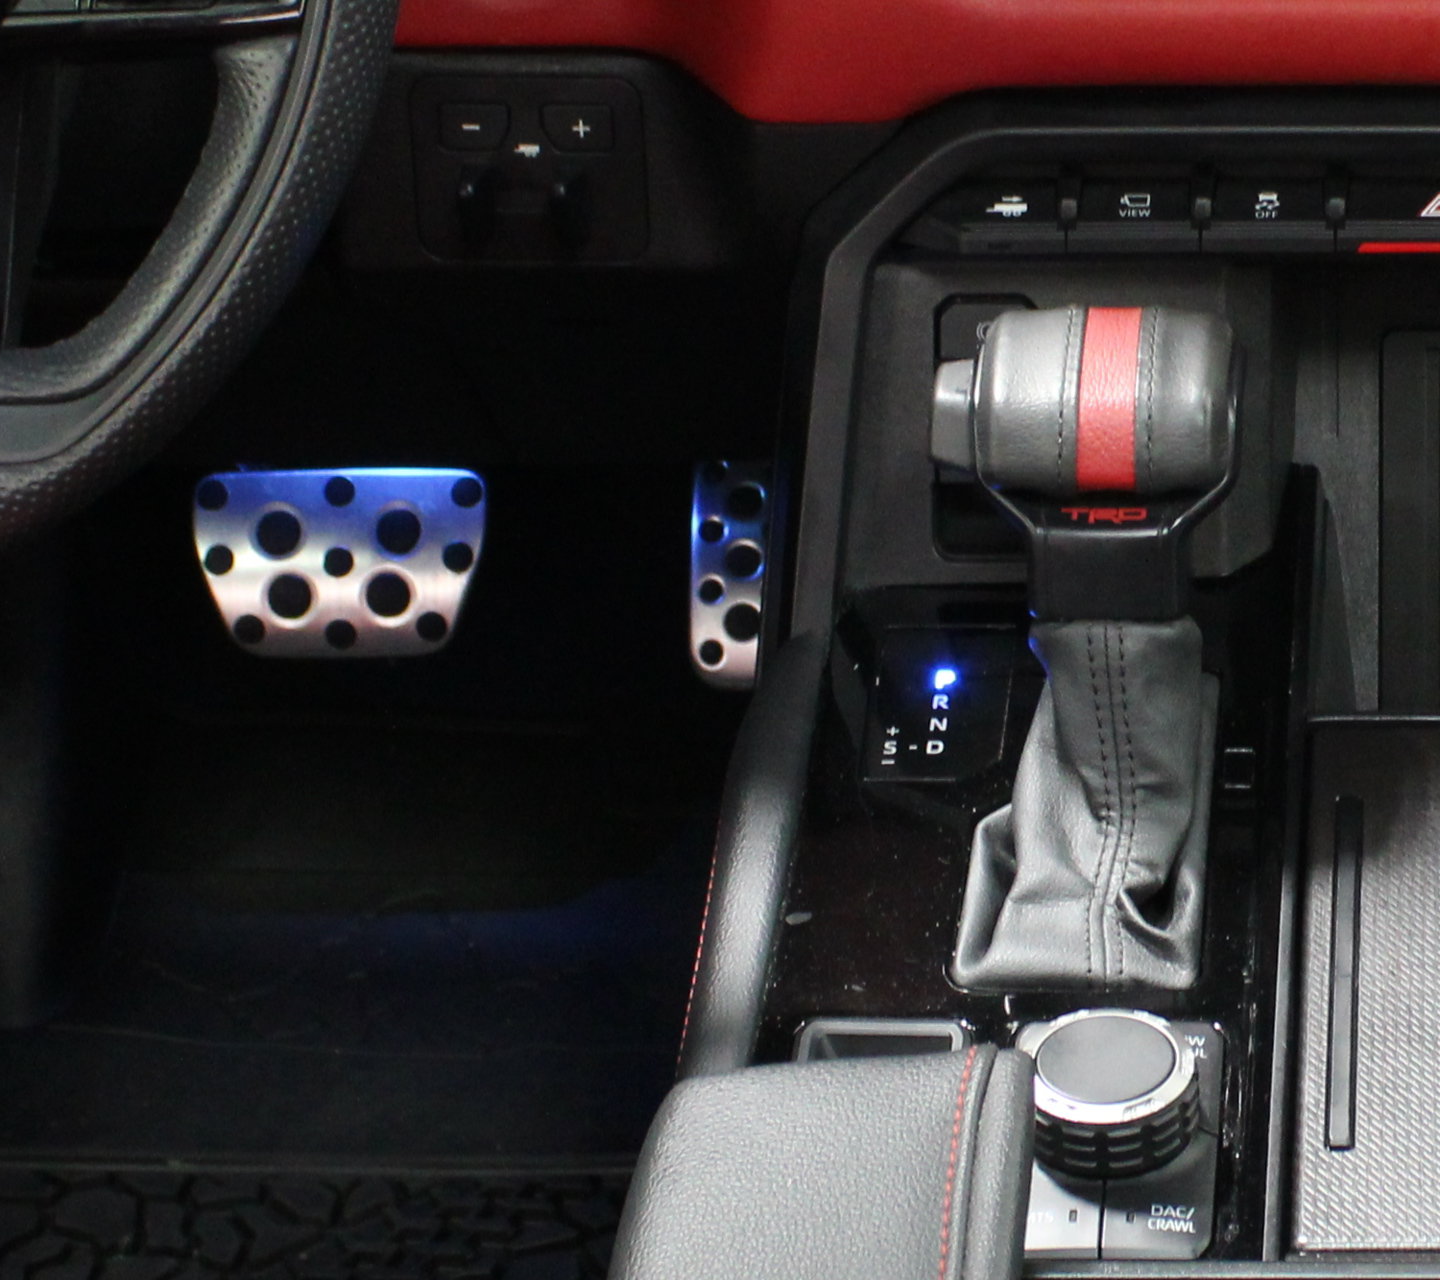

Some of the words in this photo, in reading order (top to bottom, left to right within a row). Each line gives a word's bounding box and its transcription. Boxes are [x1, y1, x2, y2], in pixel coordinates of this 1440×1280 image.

[1118, 208, 1151, 219] VIEW
[1255, 209, 1279, 220] OFF
[1061, 506, 1147, 524] TRD
[934, 668, 956, 690] P
[932, 693, 949, 710] R
[929, 717, 948, 732] N
[883, 740, 897, 755] S
[925, 740, 944, 755] D
[1150, 1203, 1195, 1221] DAC/
[1147, 1218, 1197, 1234] CRAWL
